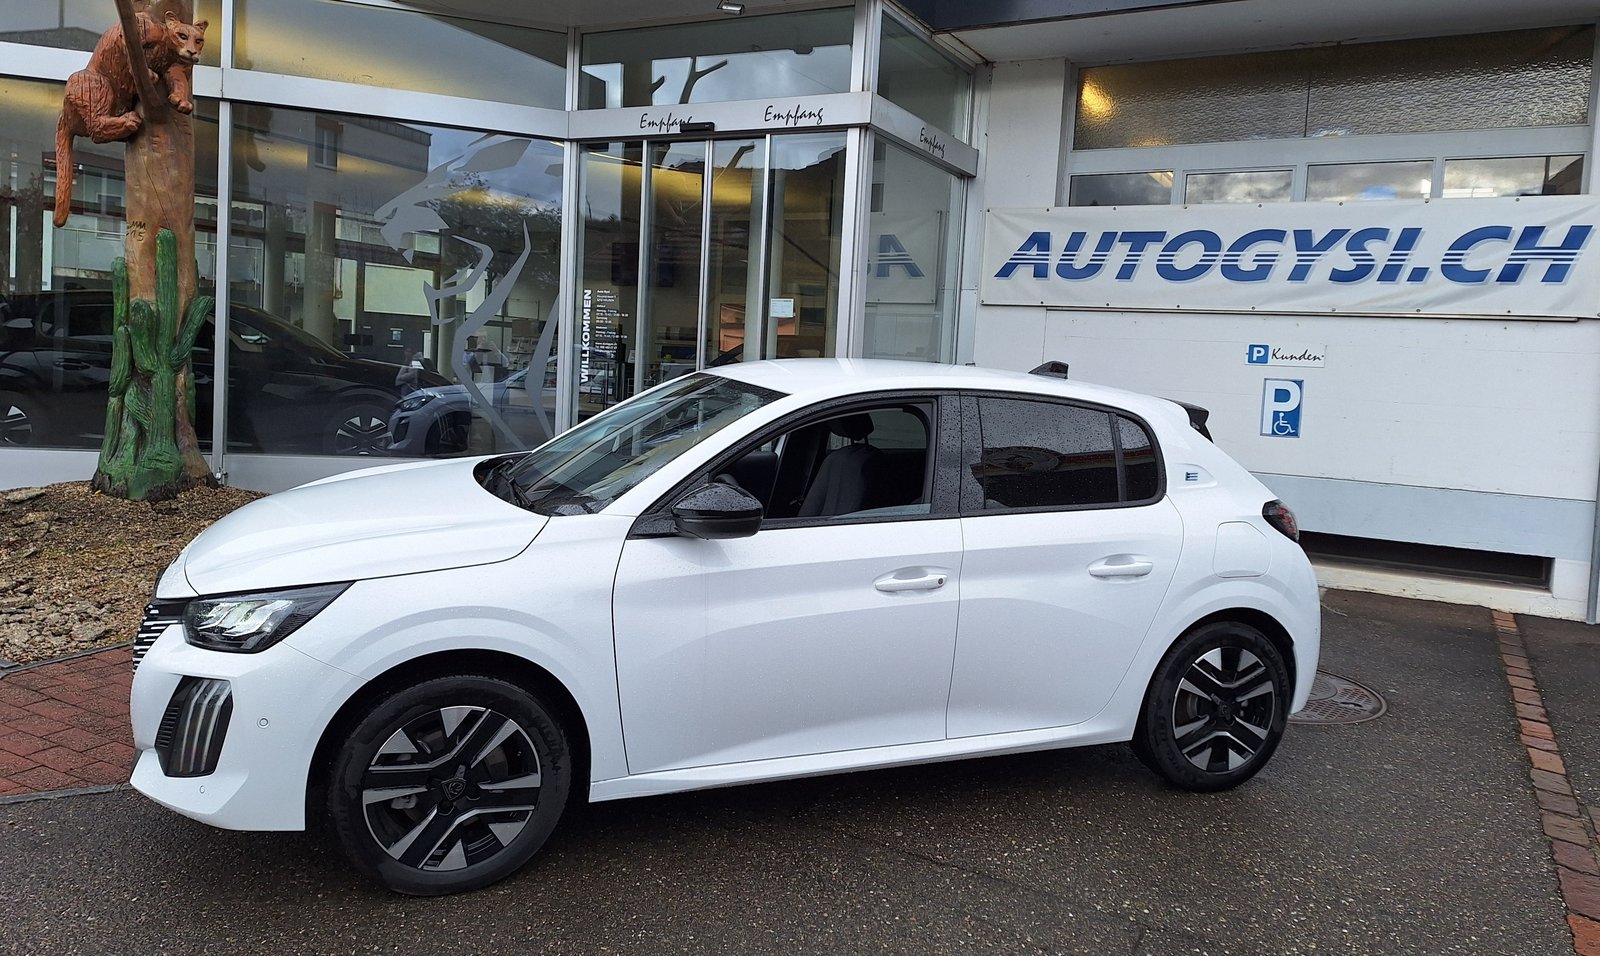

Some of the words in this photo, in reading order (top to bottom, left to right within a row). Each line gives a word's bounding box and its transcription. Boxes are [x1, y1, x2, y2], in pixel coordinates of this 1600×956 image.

[640, 112, 692, 133] Empfan
[764, 104, 824, 126] Empfang
[920, 127, 946, 159] Empfang
[994, 224, 1594, 284] AUTOGYSI.CH
[581, 289, 592, 383] WILLKOMMEN
[1252, 346, 1265, 362] P
[1271, 347, 1322, 361] Kunden
[1262, 380, 1301, 435] P
